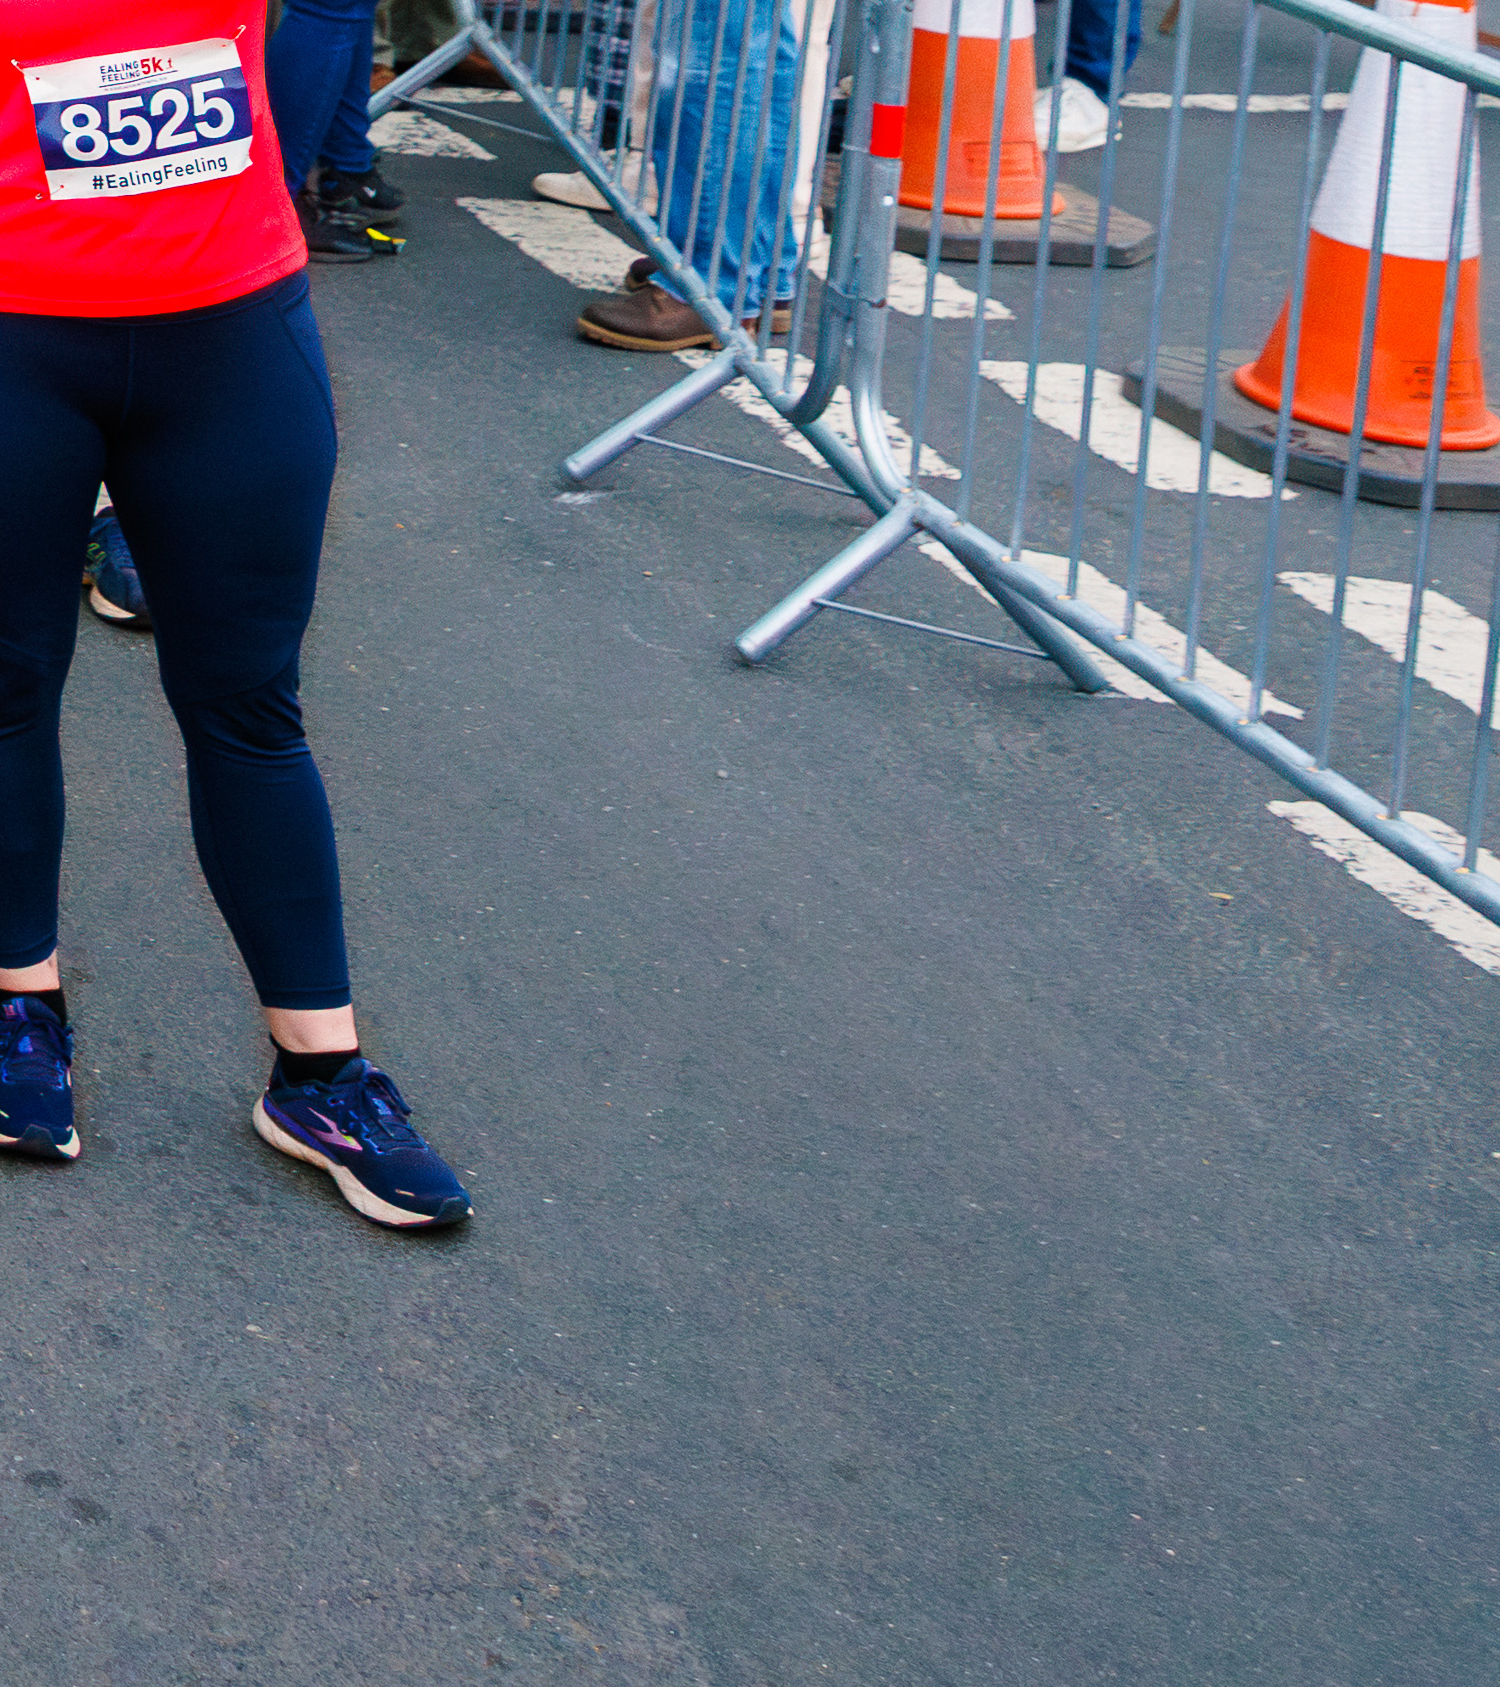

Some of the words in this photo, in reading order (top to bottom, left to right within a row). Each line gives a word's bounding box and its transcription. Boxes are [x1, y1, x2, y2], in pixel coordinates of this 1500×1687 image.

[100, 60, 139, 75] EALING
[141, 57, 164, 75] 5k
[101, 69, 141, 83] FEELING
[60, 77, 235, 161] 8525
[92, 156, 228, 190] #EalingFeeling
